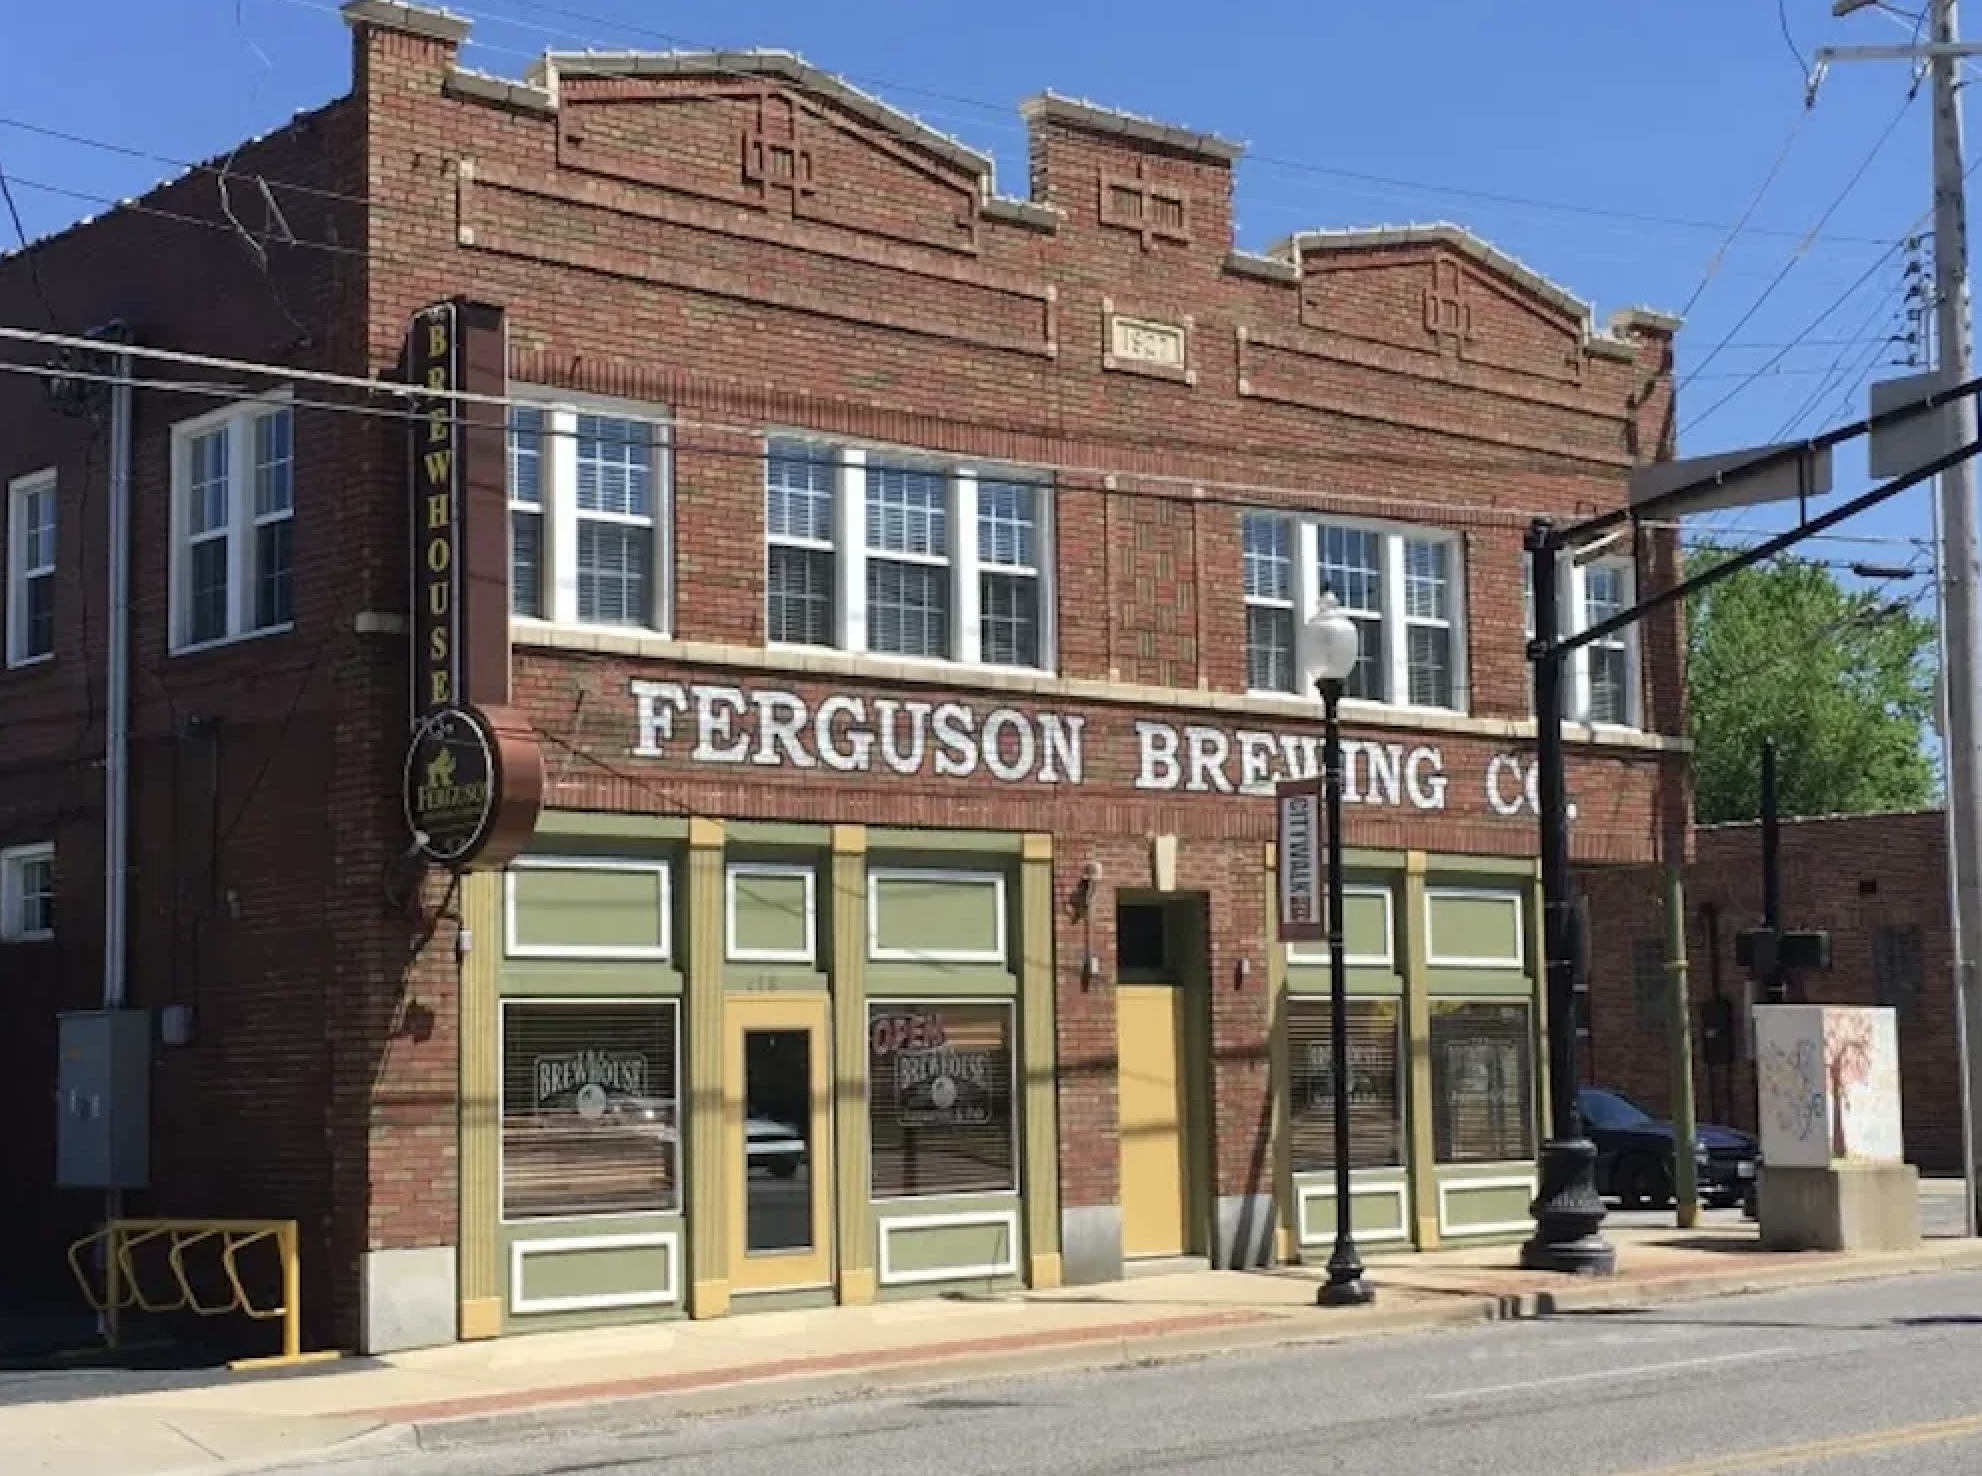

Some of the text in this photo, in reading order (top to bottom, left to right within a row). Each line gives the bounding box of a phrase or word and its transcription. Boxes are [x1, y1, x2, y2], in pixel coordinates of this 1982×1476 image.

[424, 325, 452, 704] BREWHOUSE
[629, 679, 1086, 784] FERGUSON
[1134, 721, 1449, 809] BREWING
[873, 1015, 946, 1055] OPEN
